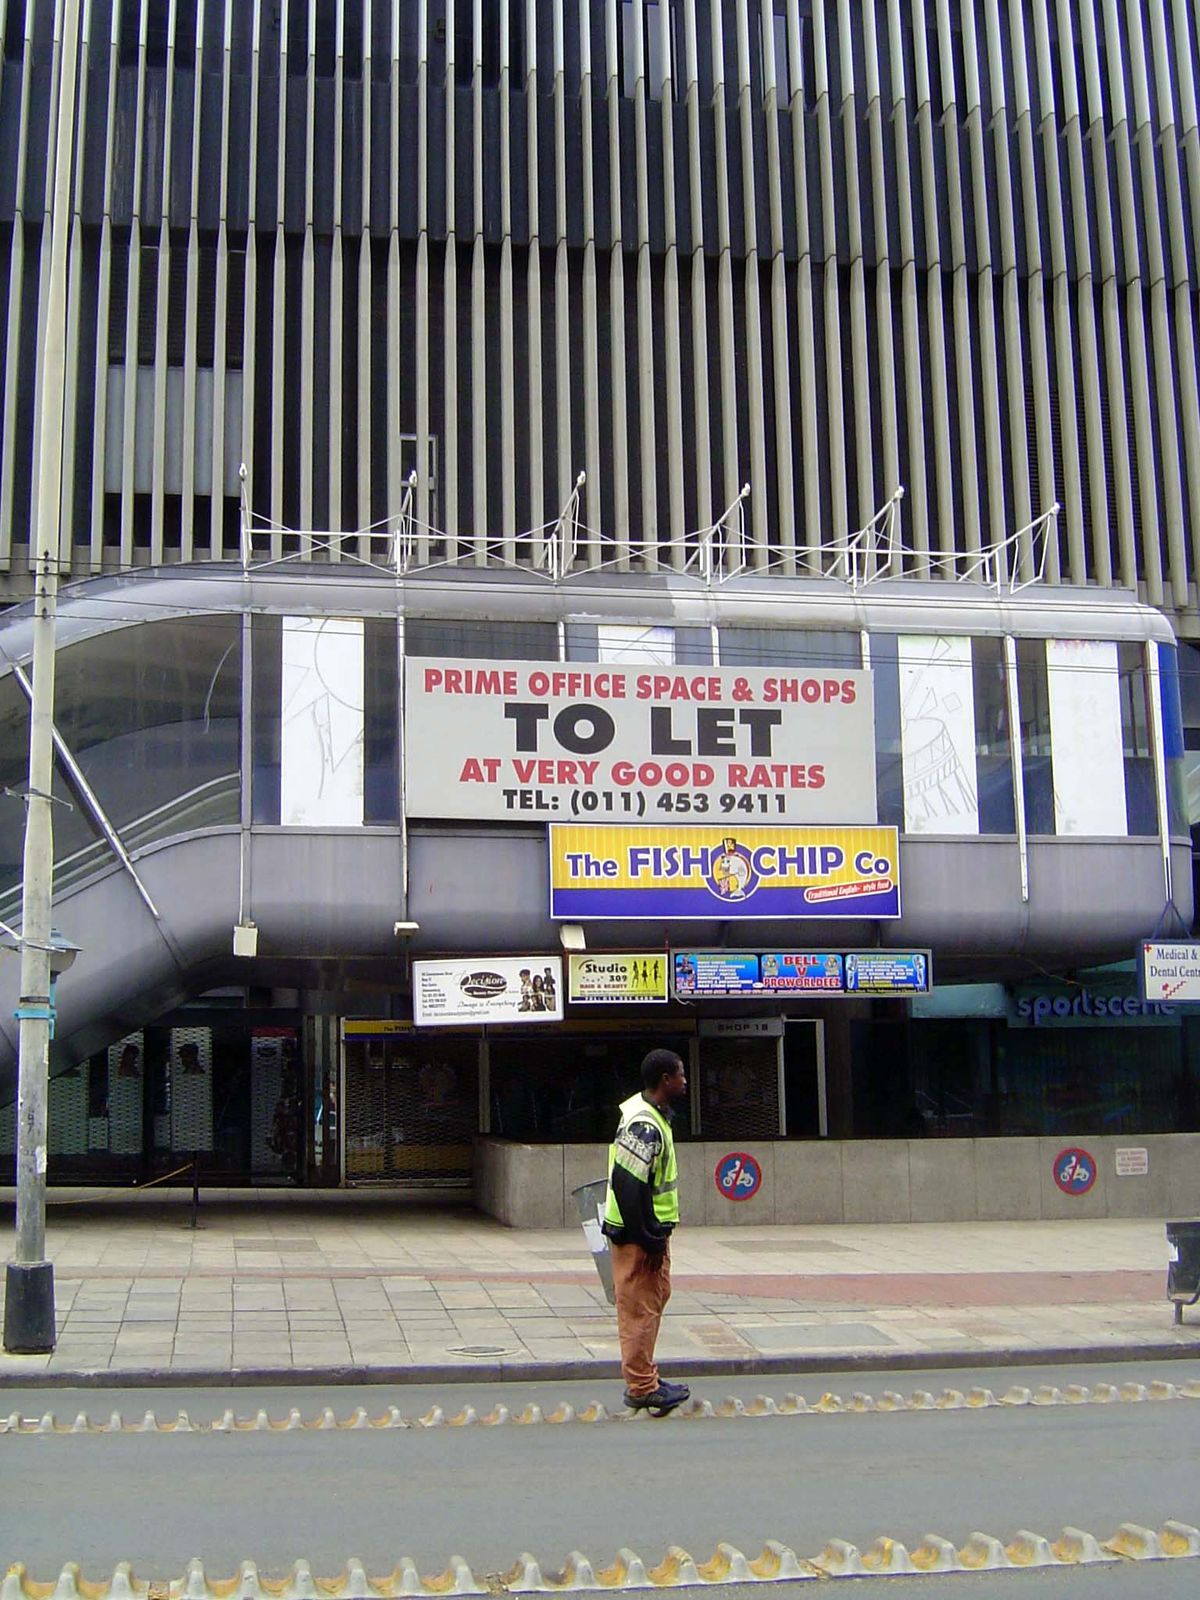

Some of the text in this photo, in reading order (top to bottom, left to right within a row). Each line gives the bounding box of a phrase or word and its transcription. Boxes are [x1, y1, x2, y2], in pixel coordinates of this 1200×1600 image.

[424, 669, 856, 704] PRIME OFFICE SPACE & SHOPS
[504, 703, 782, 757] TO LET
[459, 758, 825, 789] AT VERY GOOD RATES
[503, 790, 787, 817] TEL: (011) 453 9411
[567, 846, 890, 878] The FISH CHIP Co
[585, 963, 627, 973] Studio
[784, 956, 818, 966] BELL
[1156, 948, 1198, 960] Medical &
[1150, 965, 1178, 977] Dental
[1017, 989, 1175, 1026] sportscene
